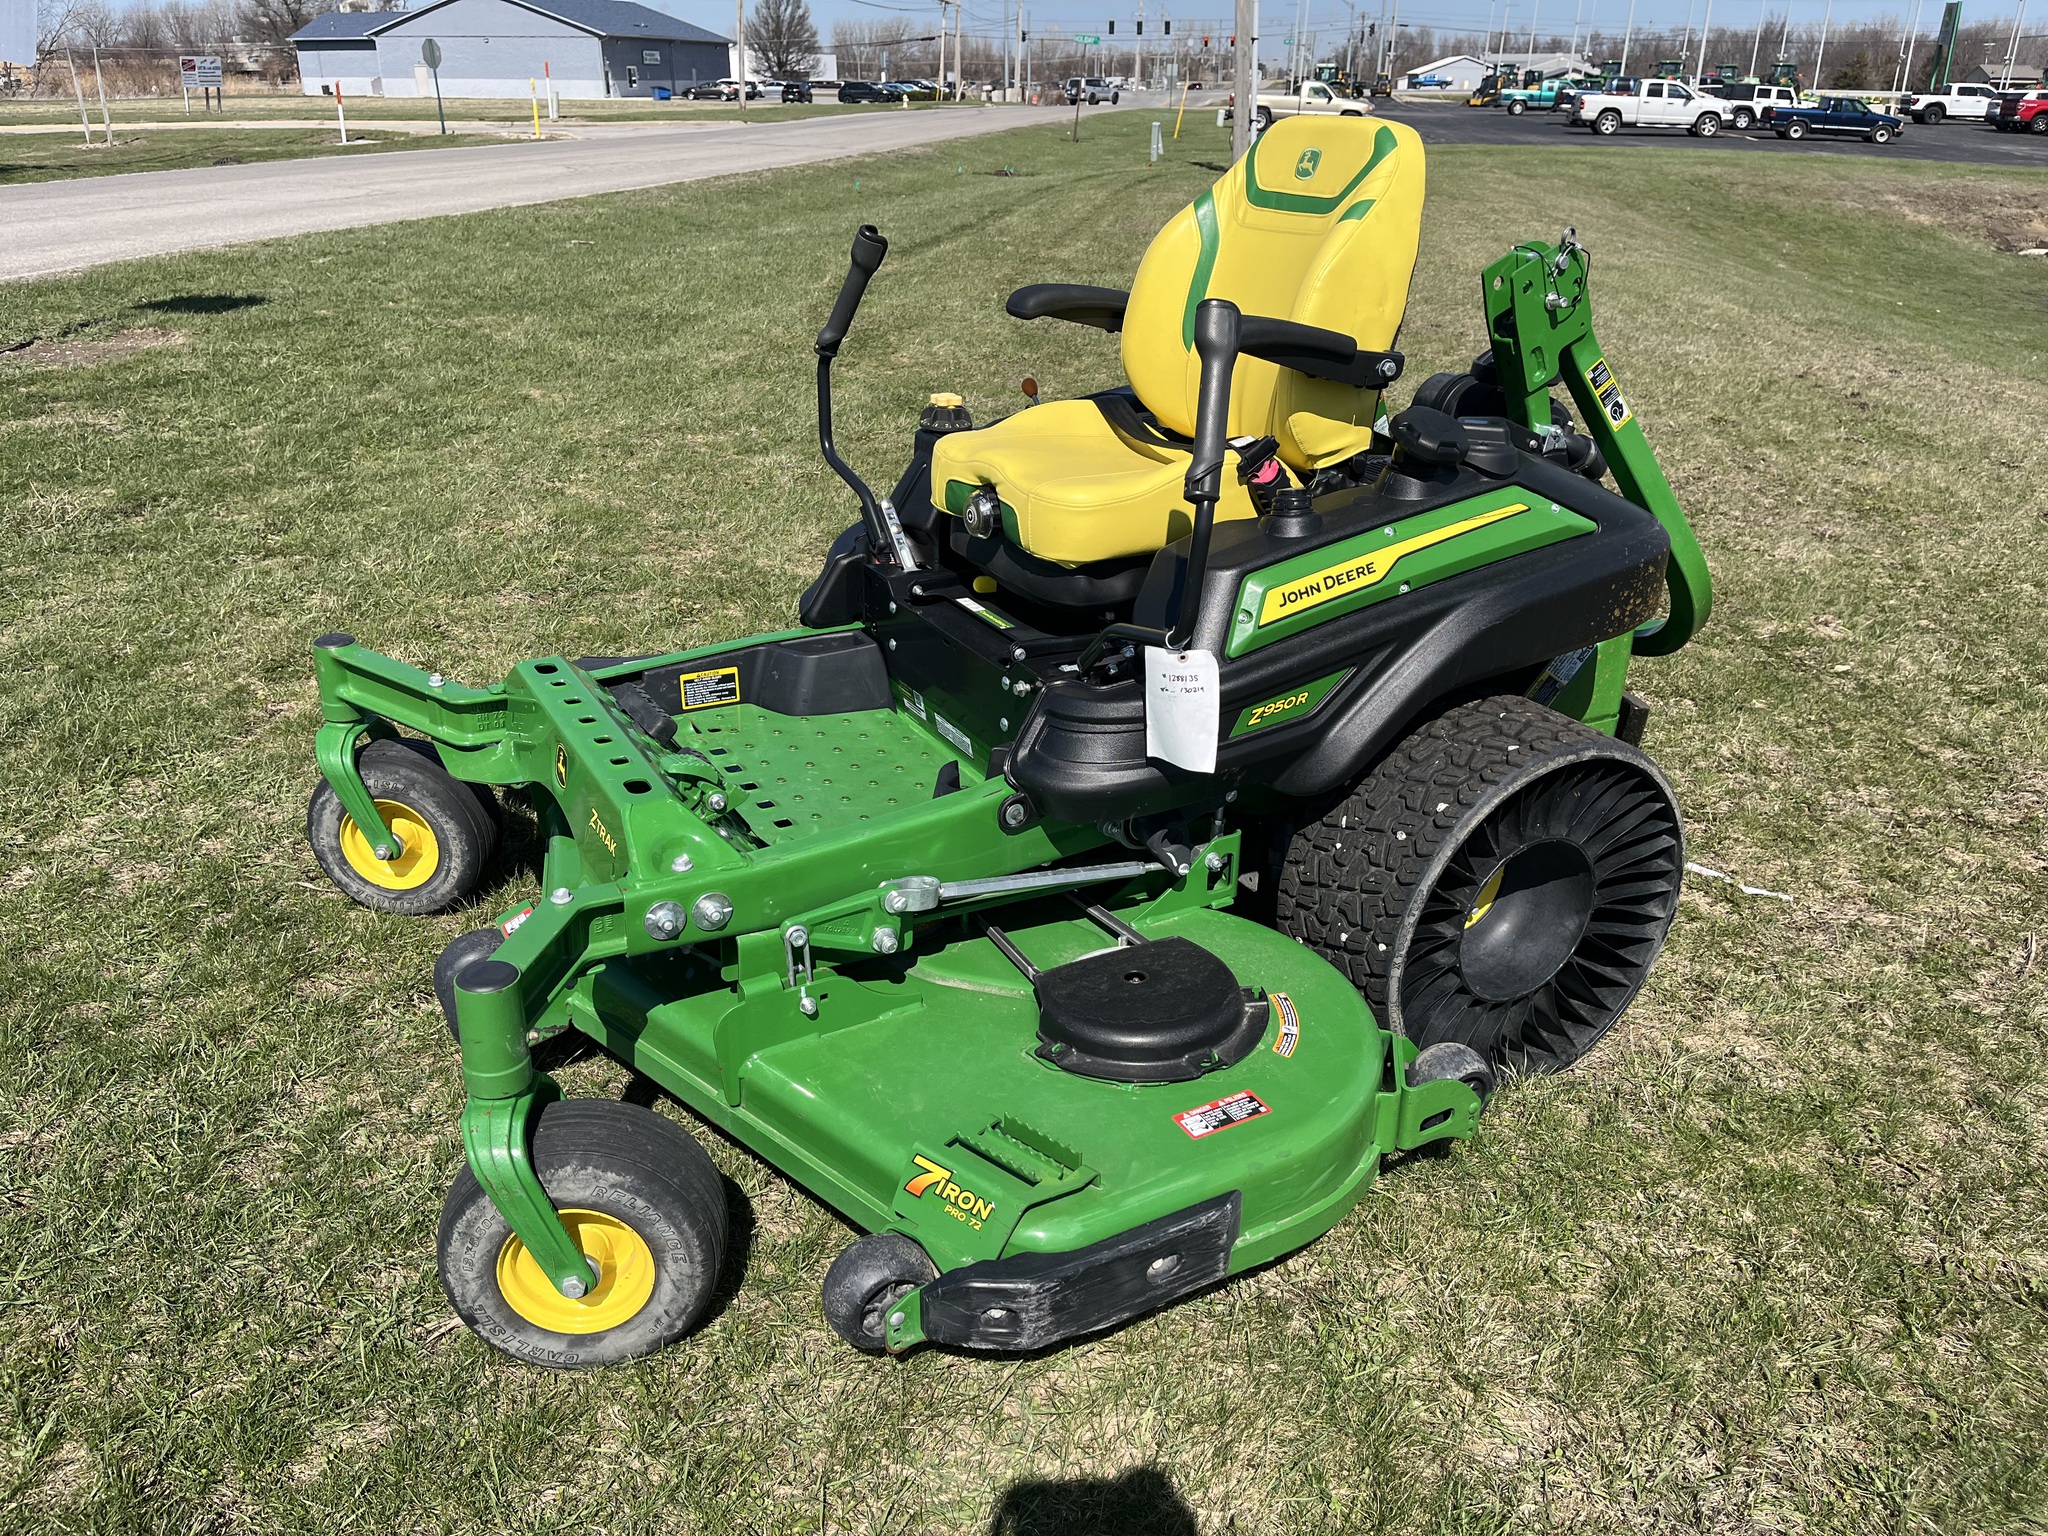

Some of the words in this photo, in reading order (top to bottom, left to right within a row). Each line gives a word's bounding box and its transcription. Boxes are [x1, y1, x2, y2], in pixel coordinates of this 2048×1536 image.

[1279, 582, 1321, 608] JOHN
[1323, 562, 1377, 591] DEERE
[1247, 691, 1309, 727] Z950R
[588, 807, 618, 858] ZTRAK
[1189, 1104, 1212, 1116] DANGER
[1223, 1092, 1248, 1104] PELIGRO
[590, 1185, 688, 1264] RELIANCE
[943, 1204, 967, 1222] PRO
[967, 1217, 983, 1231] 72
[469, 1304, 580, 1365] CARLISLE
